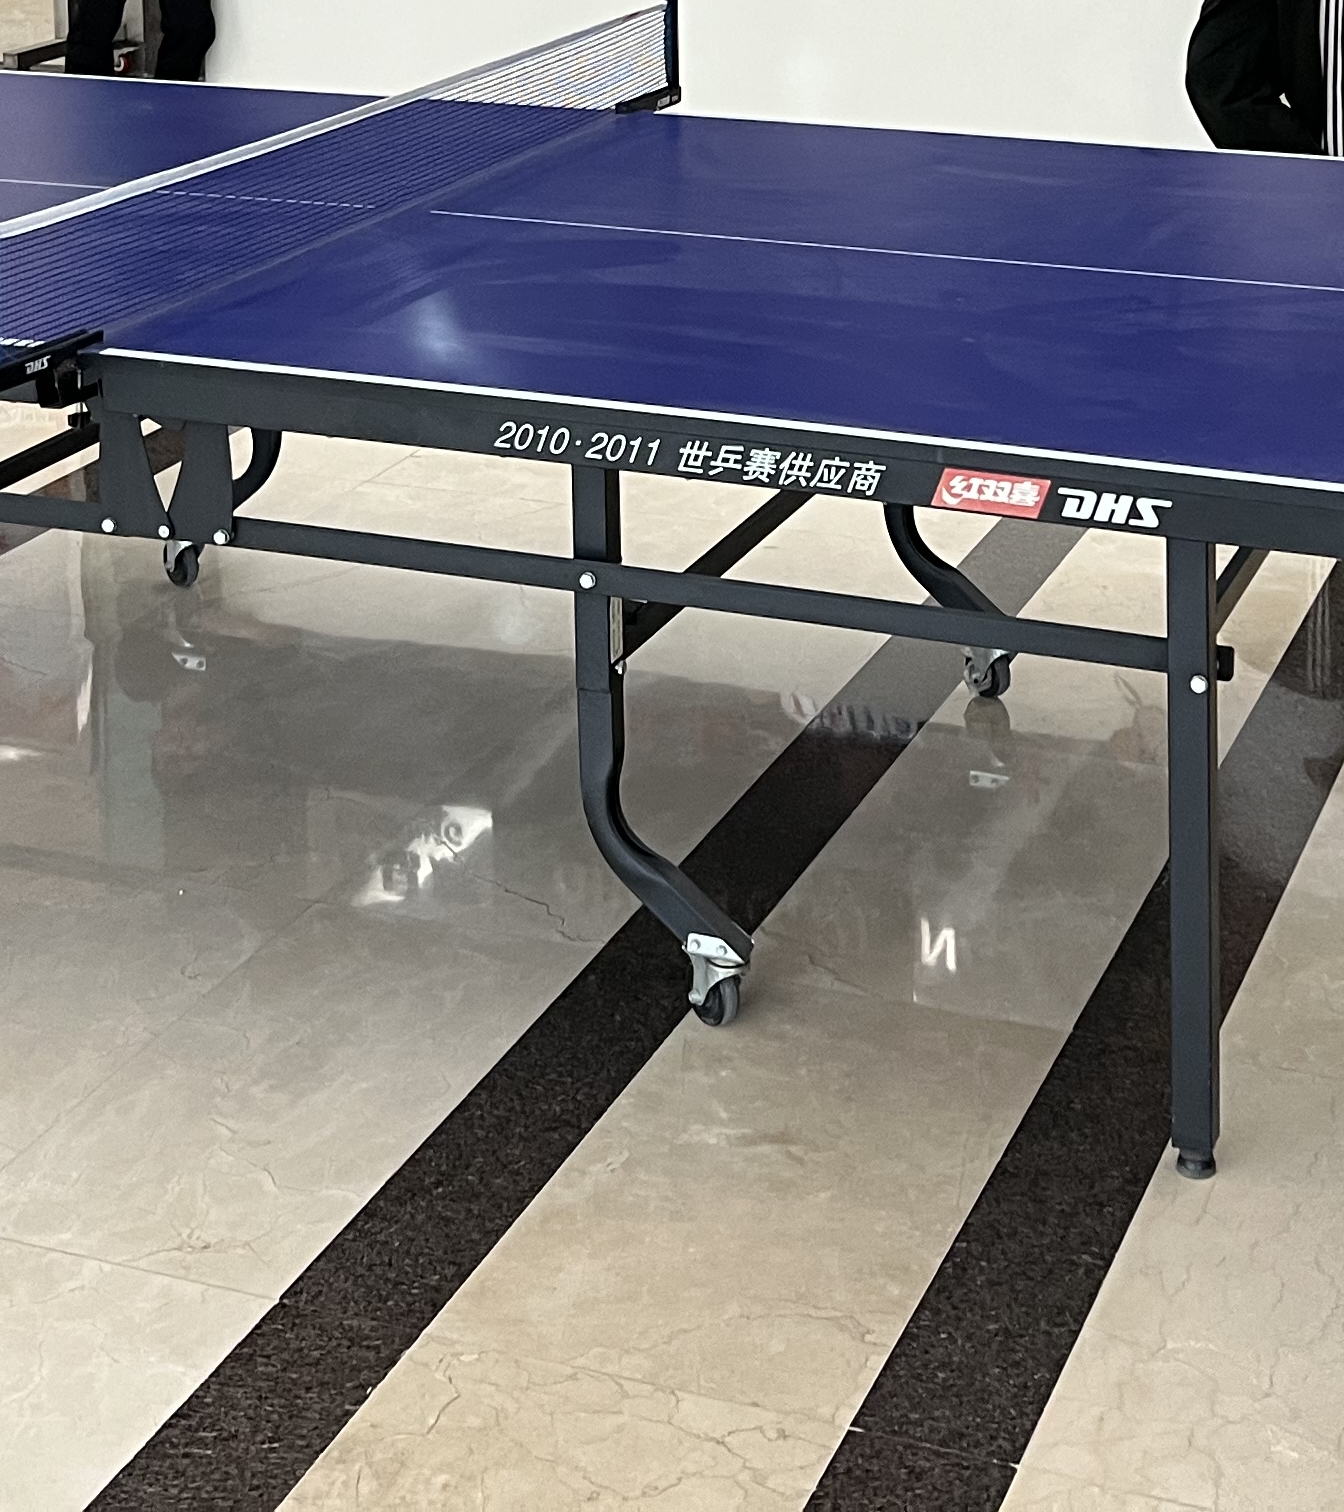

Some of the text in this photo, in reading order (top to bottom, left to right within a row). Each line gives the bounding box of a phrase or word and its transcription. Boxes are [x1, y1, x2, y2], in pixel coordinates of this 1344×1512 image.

[677, 437, 886, 497] 世乒赛供应商
[942, 476, 1173, 529] 红双喜 DHS
